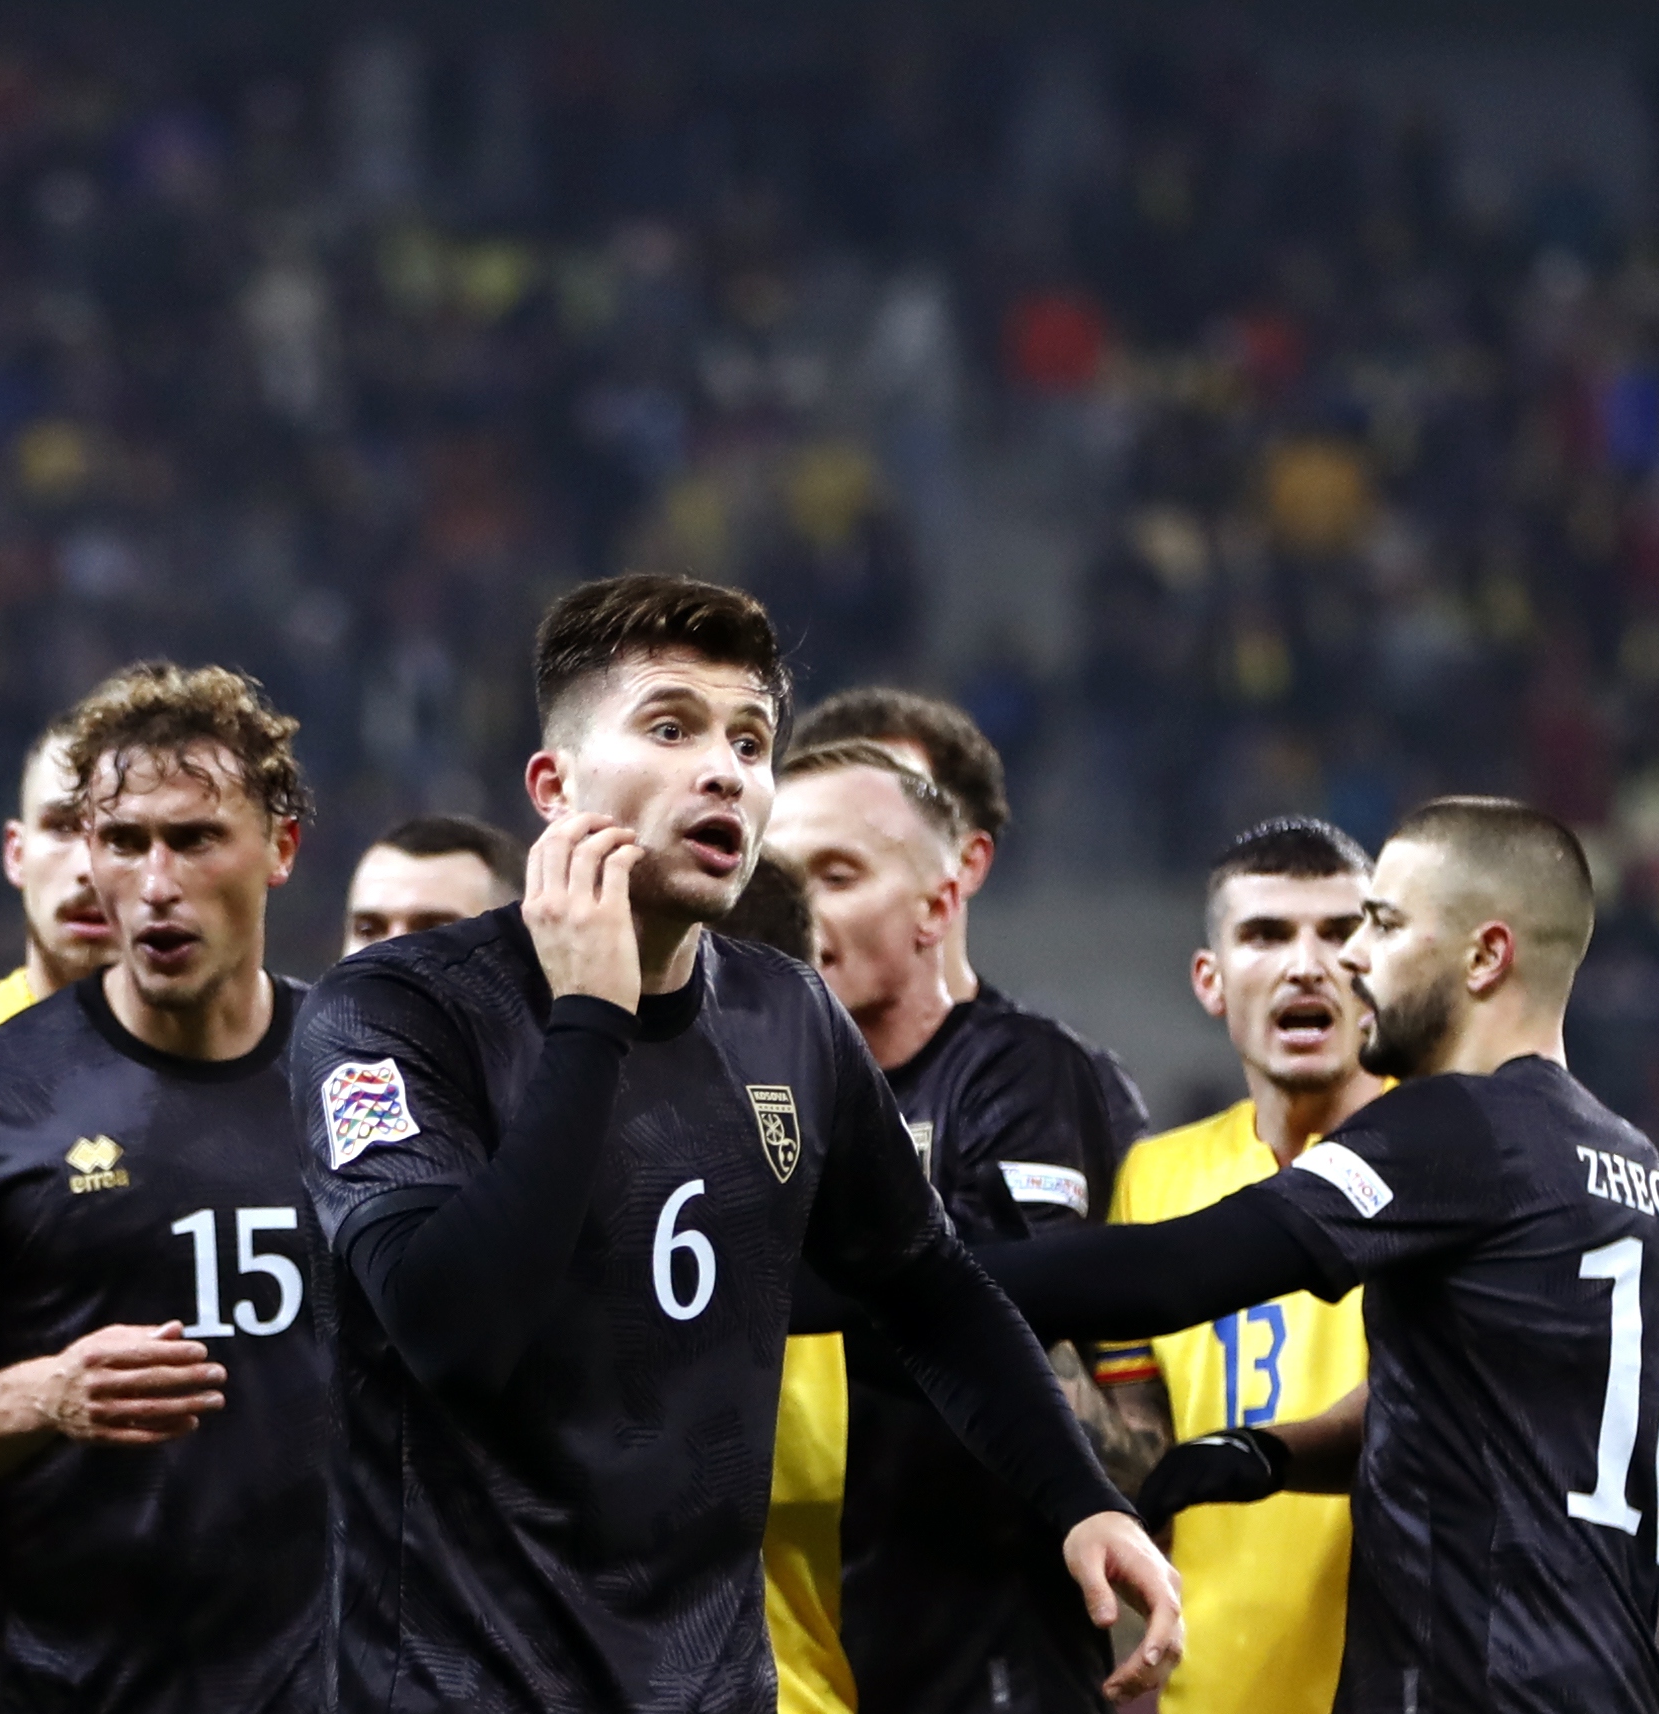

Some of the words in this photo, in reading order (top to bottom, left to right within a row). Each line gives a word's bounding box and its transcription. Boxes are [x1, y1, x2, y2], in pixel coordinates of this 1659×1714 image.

[171, 1207, 304, 1338] 15
[653, 1179, 717, 1321] 6
[1213, 1304, 1286, 1429] 13
